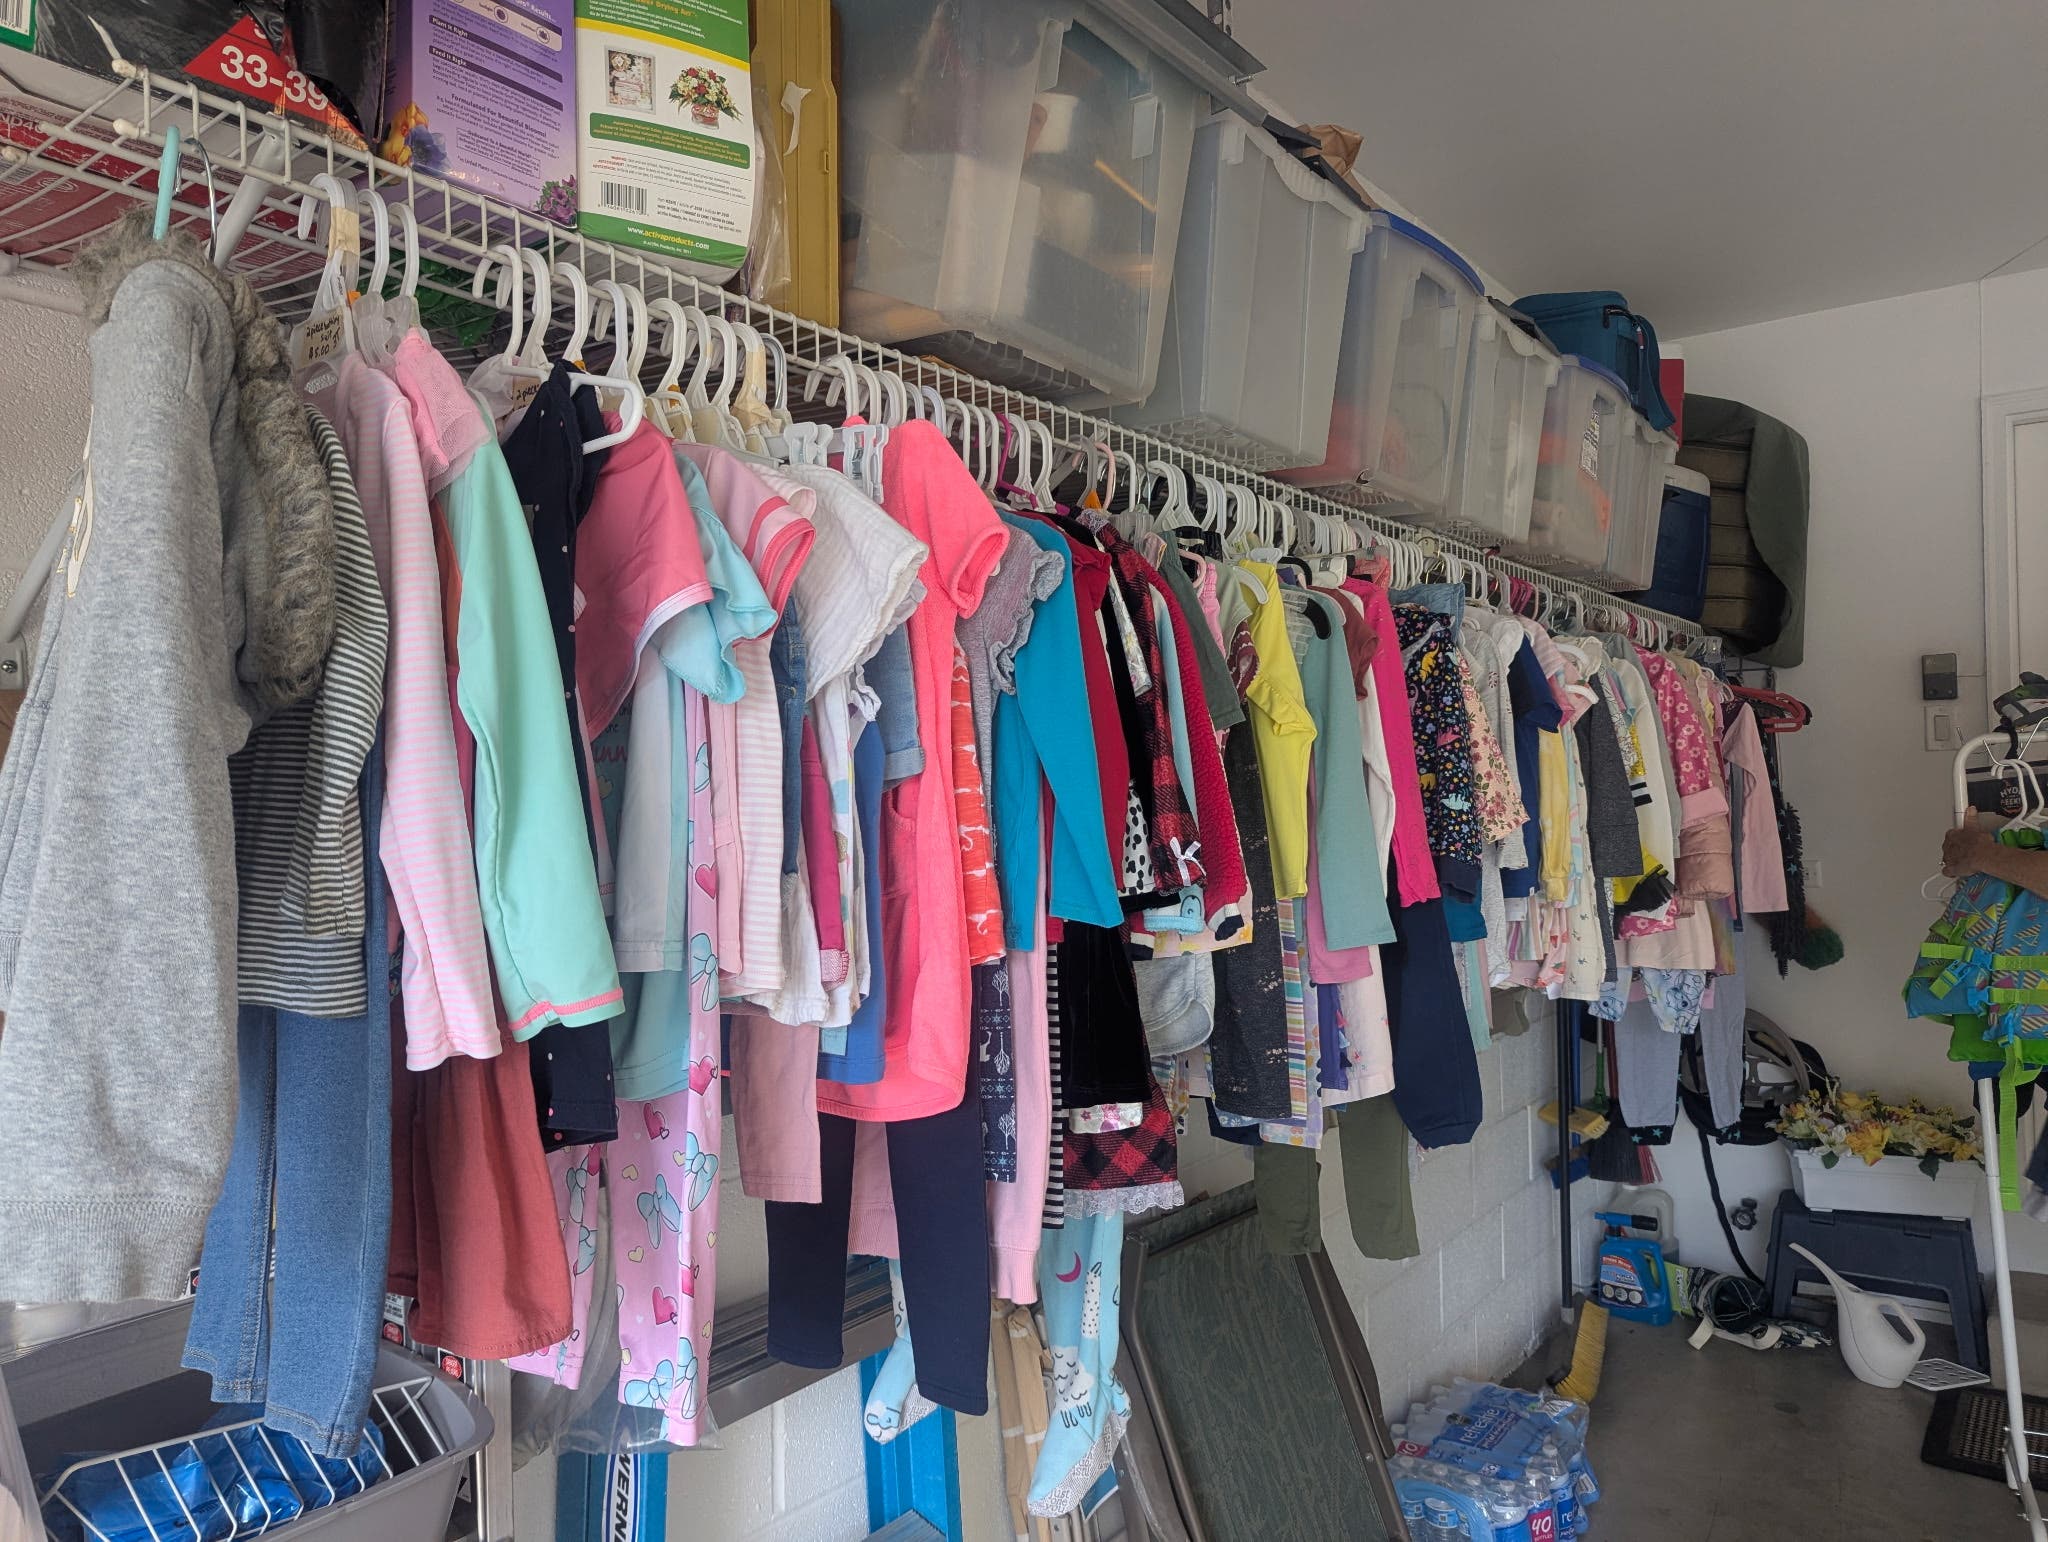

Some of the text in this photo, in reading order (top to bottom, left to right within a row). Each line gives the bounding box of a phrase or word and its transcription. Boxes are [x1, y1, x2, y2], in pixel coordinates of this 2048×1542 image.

[220, 45, 328, 111] 33-39
[628, 226, 710, 250] www.activaproducts.com
[1531, 1515, 1552, 1536] 40
